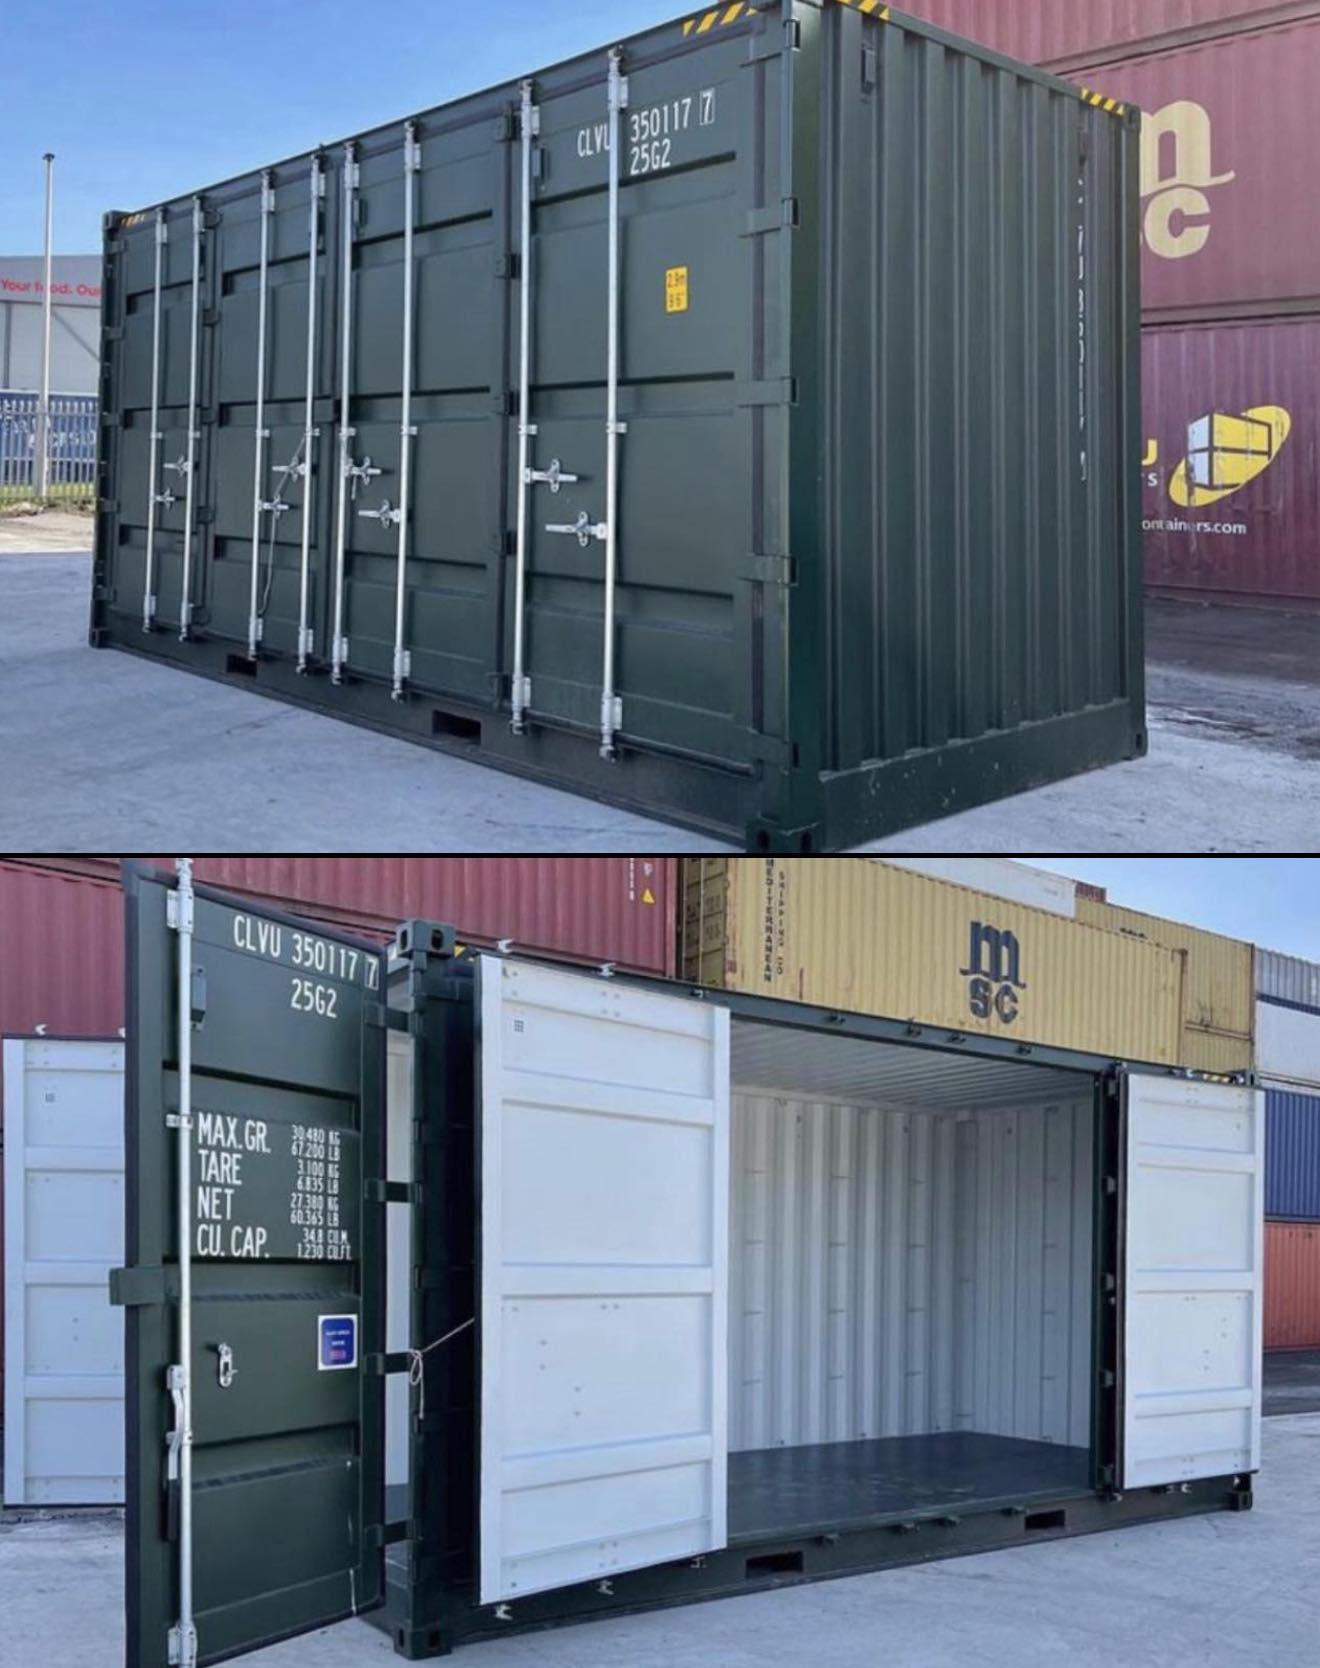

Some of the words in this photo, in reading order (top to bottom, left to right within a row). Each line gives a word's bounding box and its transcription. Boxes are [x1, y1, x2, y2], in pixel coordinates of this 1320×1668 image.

[630, 97, 692, 143] 350117
[702, 89, 714, 125] 7
[629, 138, 671, 176] 25G2
[233, 915, 281, 958] CLVU
[291, 933, 358, 982] 350117
[366, 955, 379, 990] 7
[290, 978, 338, 1019] 25G2
[198, 1149, 242, 1185] TARE
[197, 1186, 235, 1220] NET
[230, 1225, 270, 1258] CAP.
